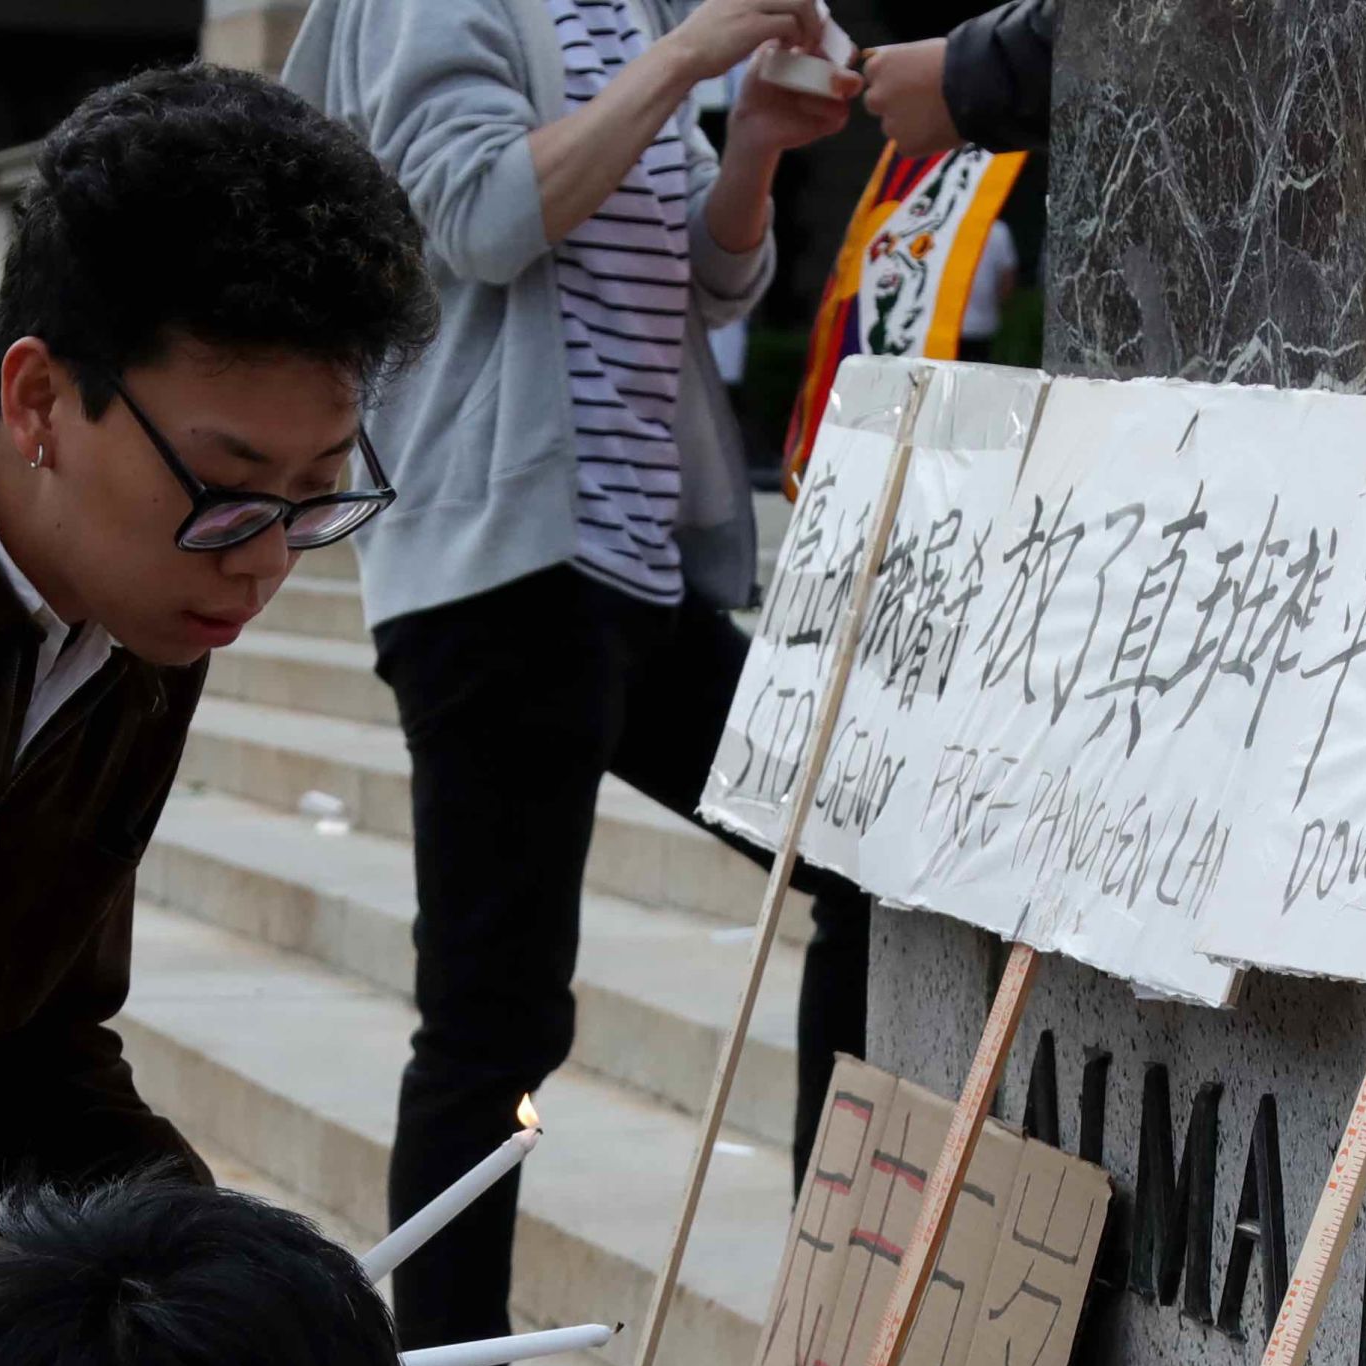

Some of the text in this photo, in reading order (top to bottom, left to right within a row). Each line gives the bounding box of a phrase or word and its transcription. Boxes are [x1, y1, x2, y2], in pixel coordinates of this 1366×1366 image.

[725, 674, 816, 803] STO
[919, 743, 1020, 849] FREE
[1010, 765, 1179, 910] PANCHEN
